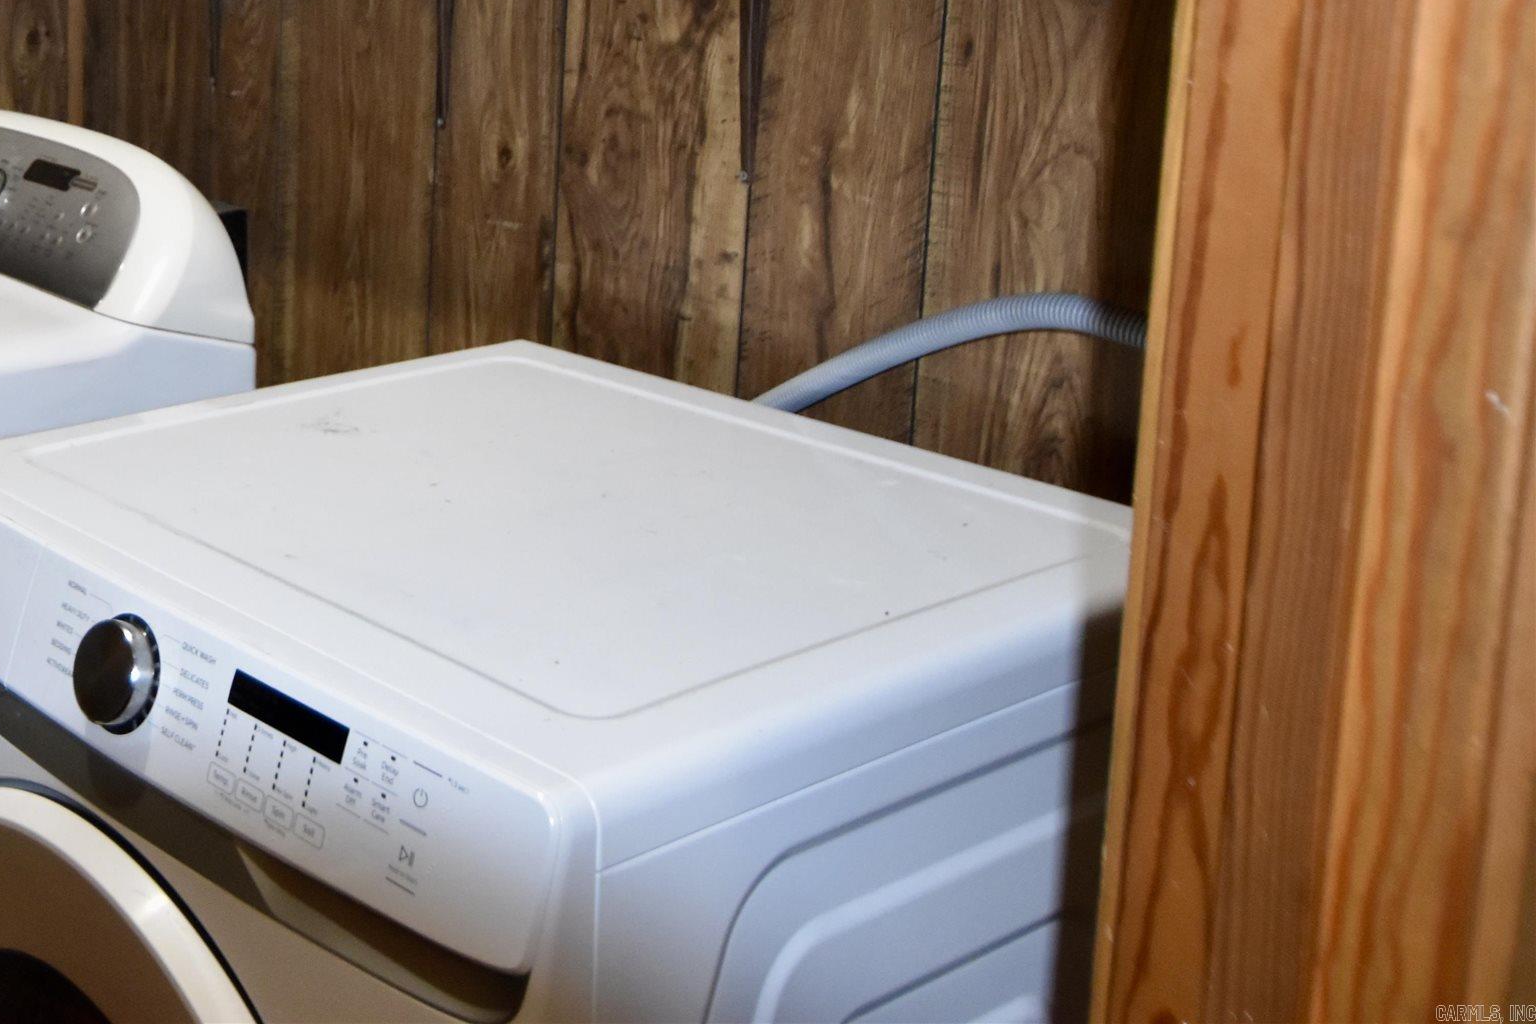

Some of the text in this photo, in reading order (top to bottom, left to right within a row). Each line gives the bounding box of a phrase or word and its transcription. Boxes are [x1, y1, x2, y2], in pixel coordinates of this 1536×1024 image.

[381, 760, 400, 777] Delay
[381, 772, 394, 785] End
[371, 797, 390, 815] Smart
